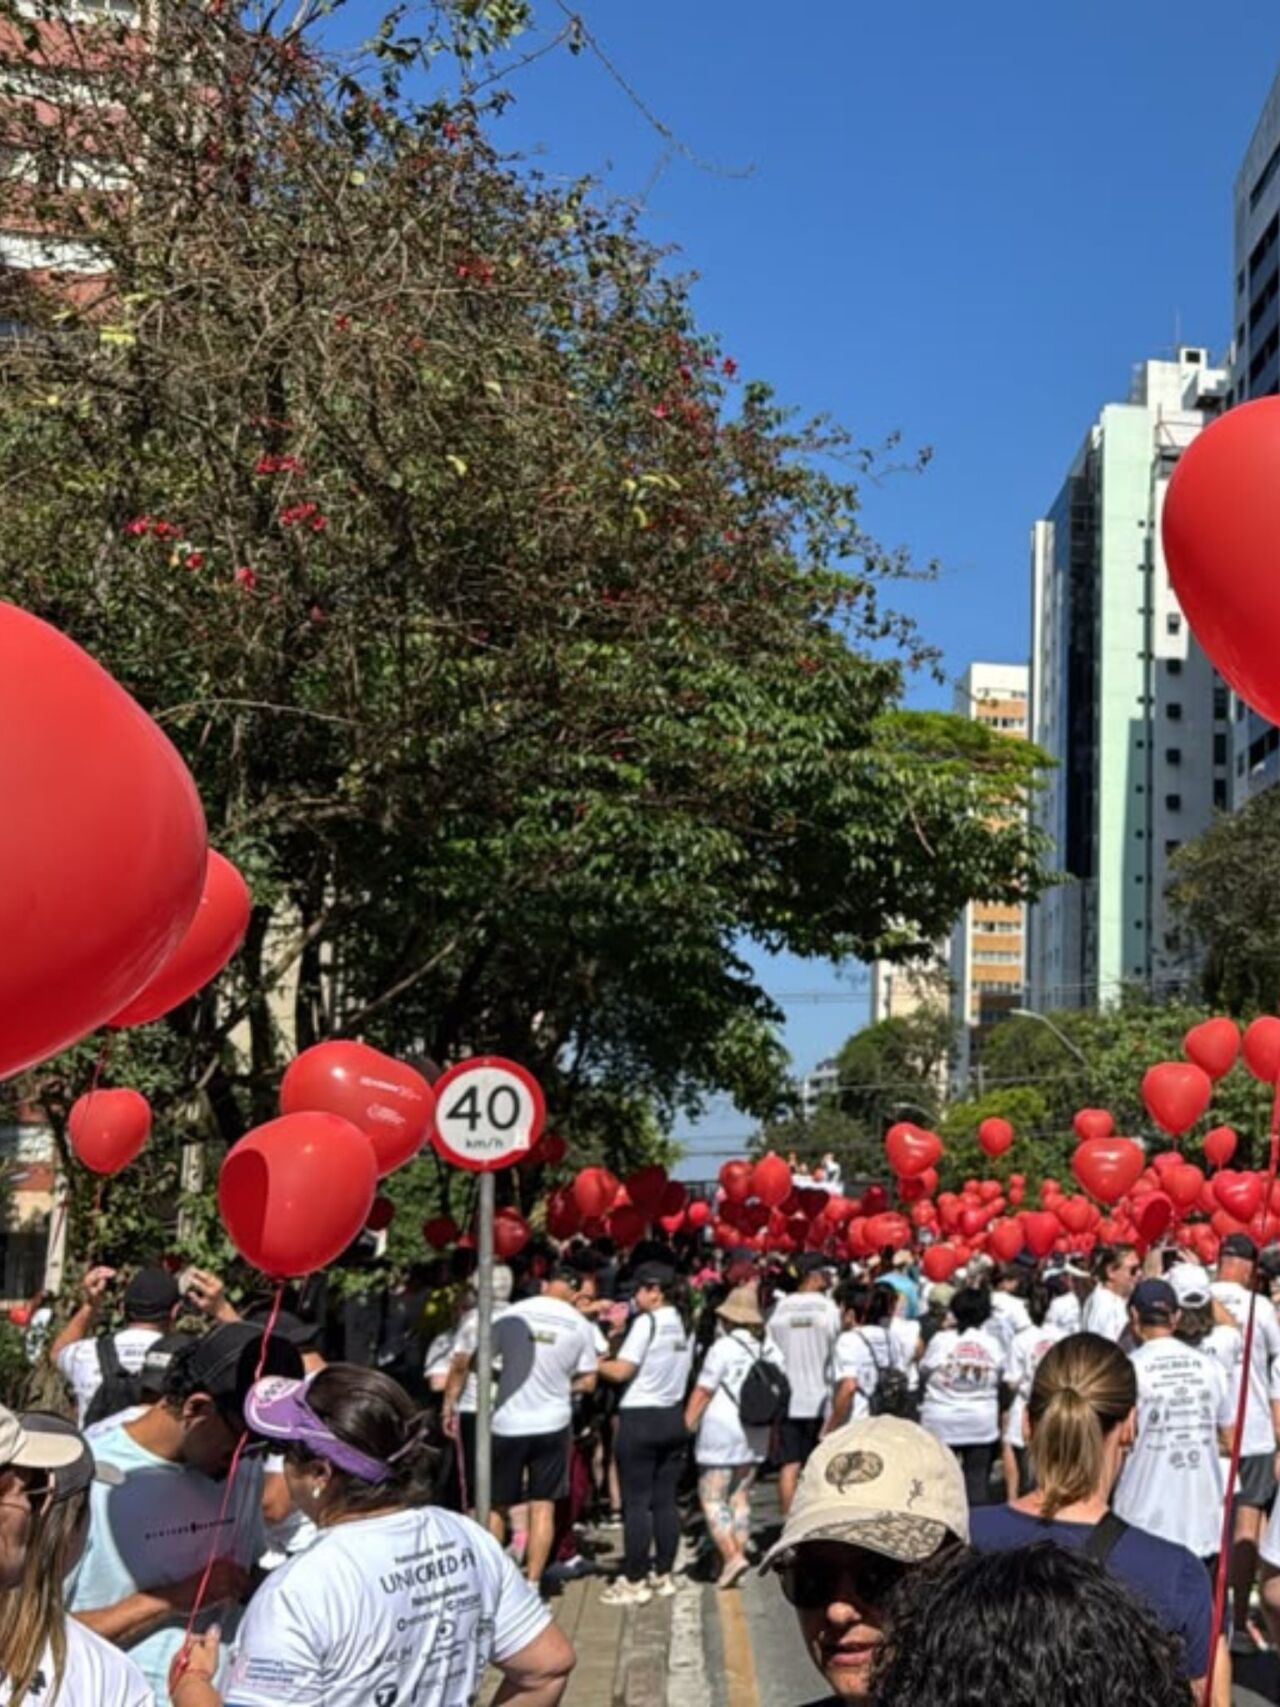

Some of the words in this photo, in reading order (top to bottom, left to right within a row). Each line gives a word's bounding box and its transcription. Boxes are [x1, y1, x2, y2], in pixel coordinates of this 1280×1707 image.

[446, 1085, 521, 1131] 40
[465, 1137, 504, 1149] km/h
[379, 1554, 458, 1594] UNICRED
